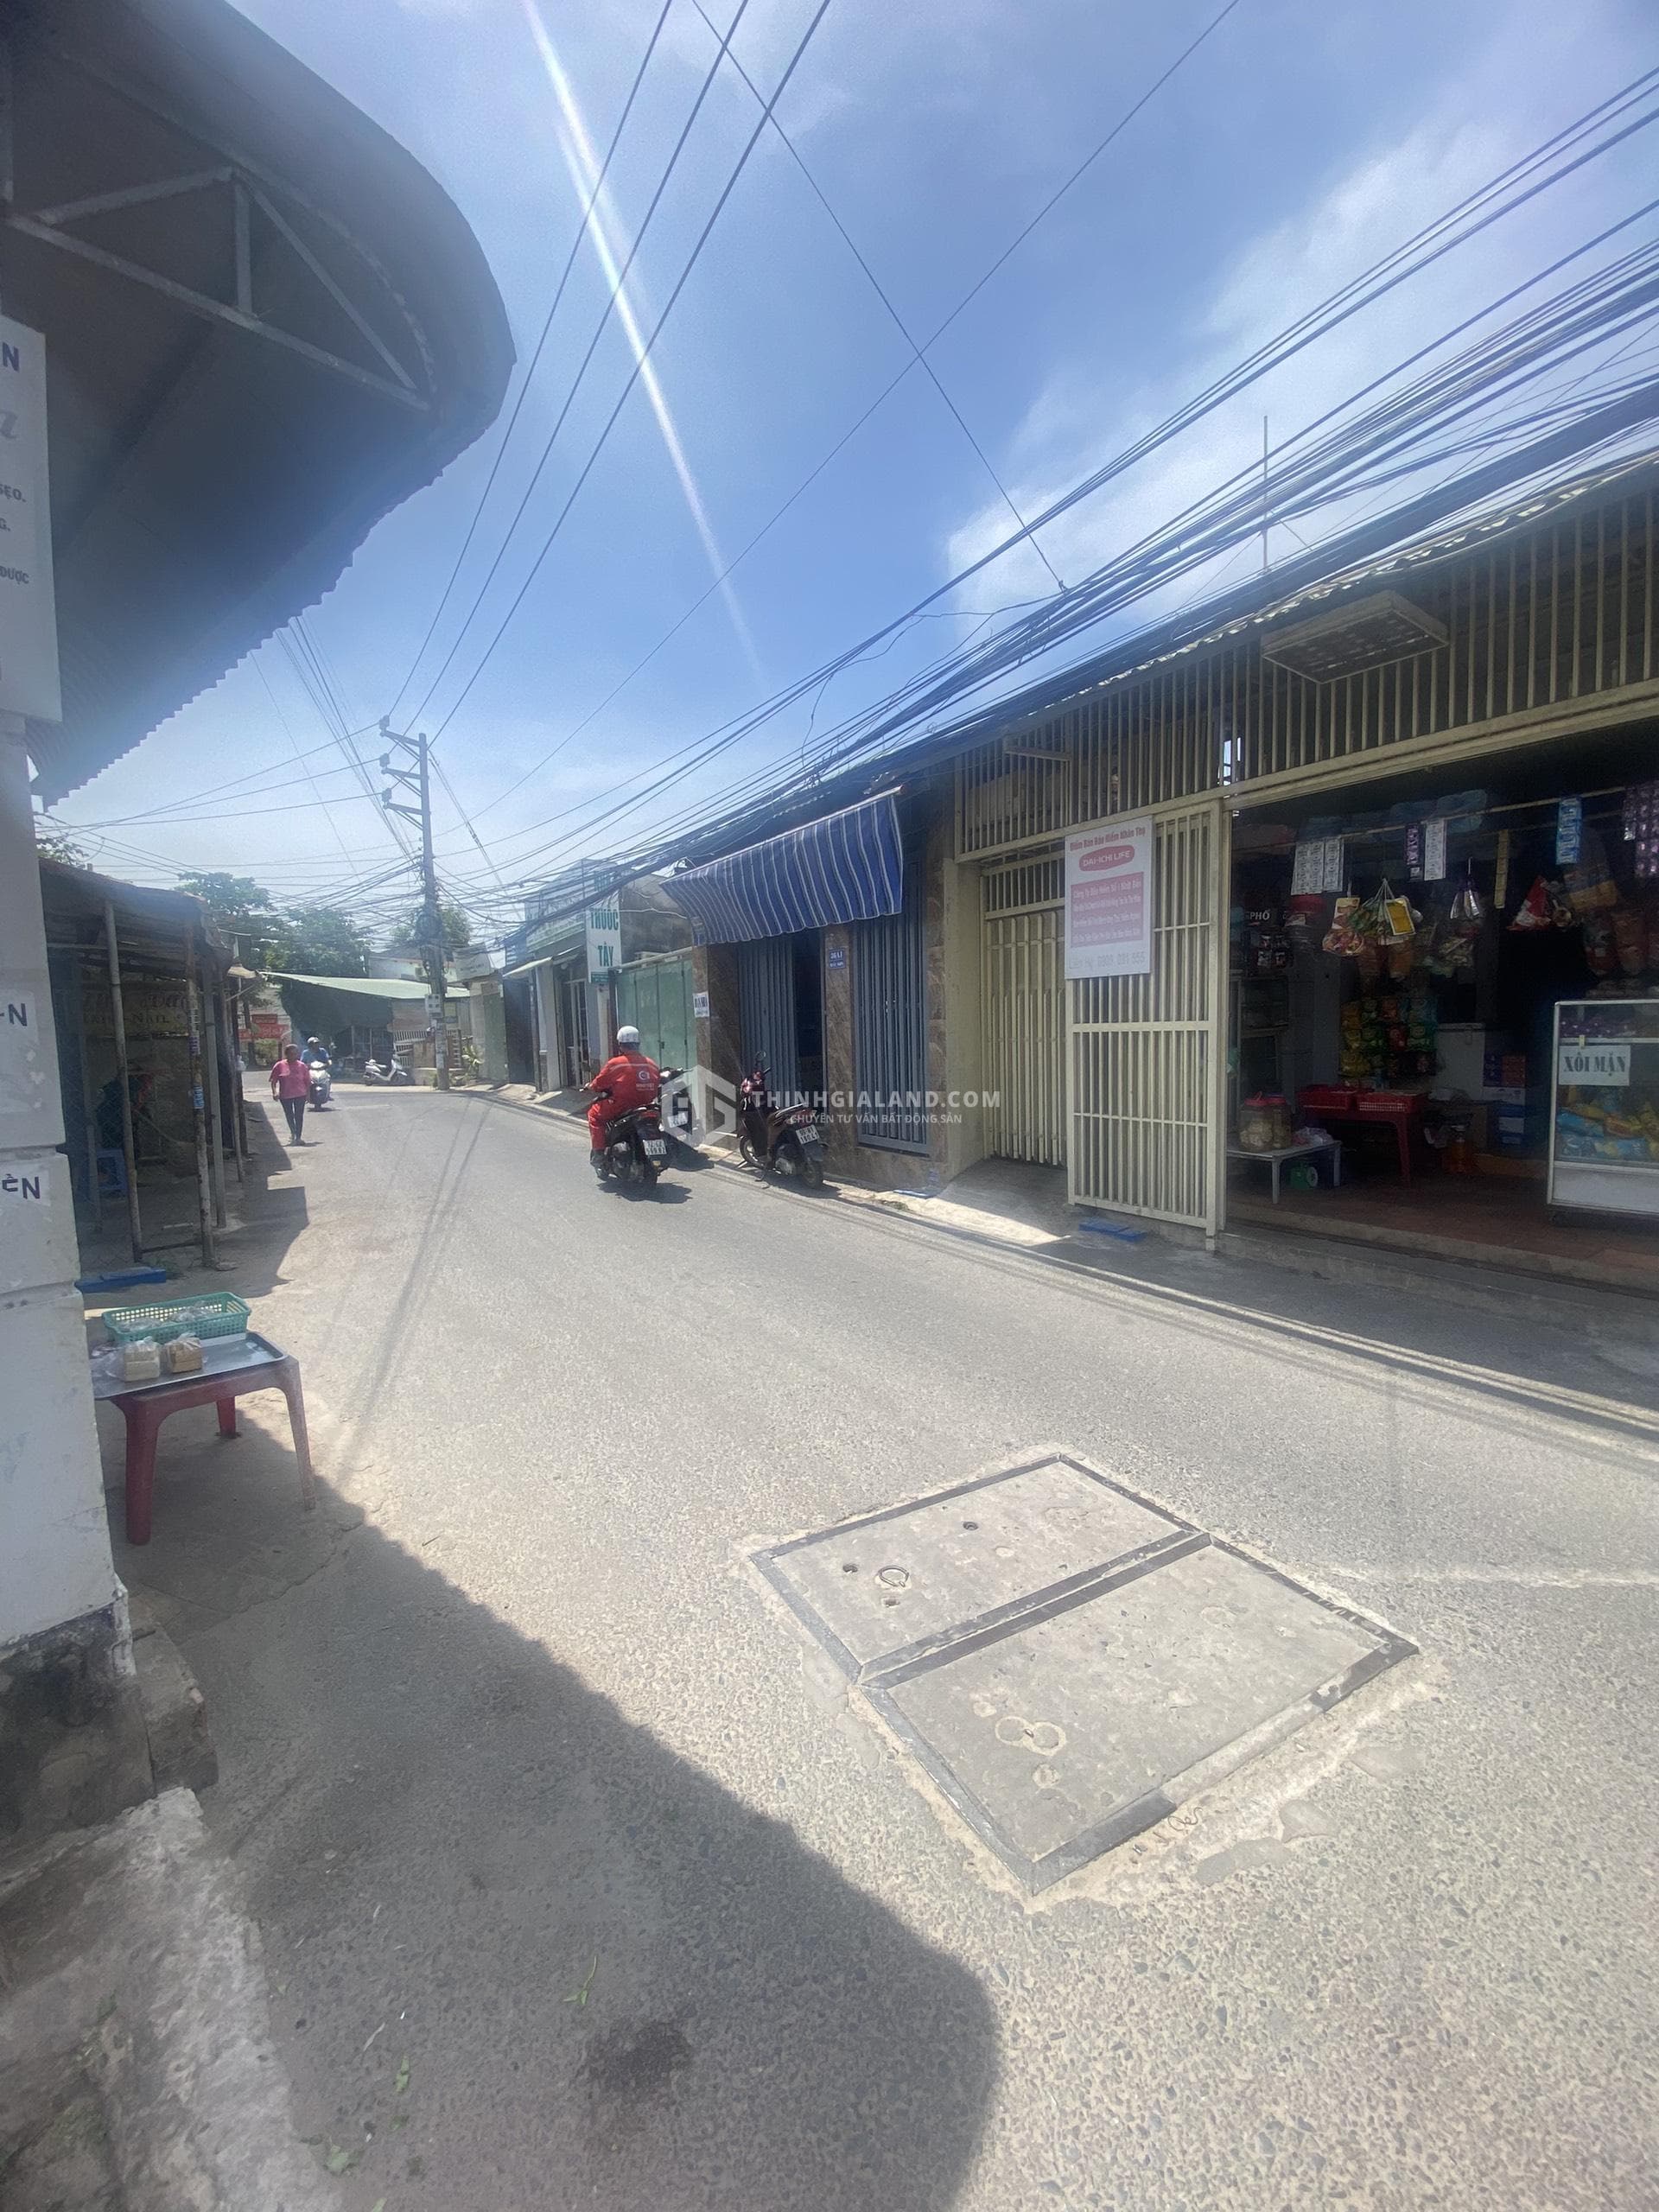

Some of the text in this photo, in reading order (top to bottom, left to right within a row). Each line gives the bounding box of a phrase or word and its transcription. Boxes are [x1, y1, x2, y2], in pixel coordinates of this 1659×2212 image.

[1114, 850, 1131, 861] LIFE
[598, 941, 613, 967] TÂY
[0, 1003, 28, 1027] N
[1563, 1052, 1626, 1077] XÔI MẶN
